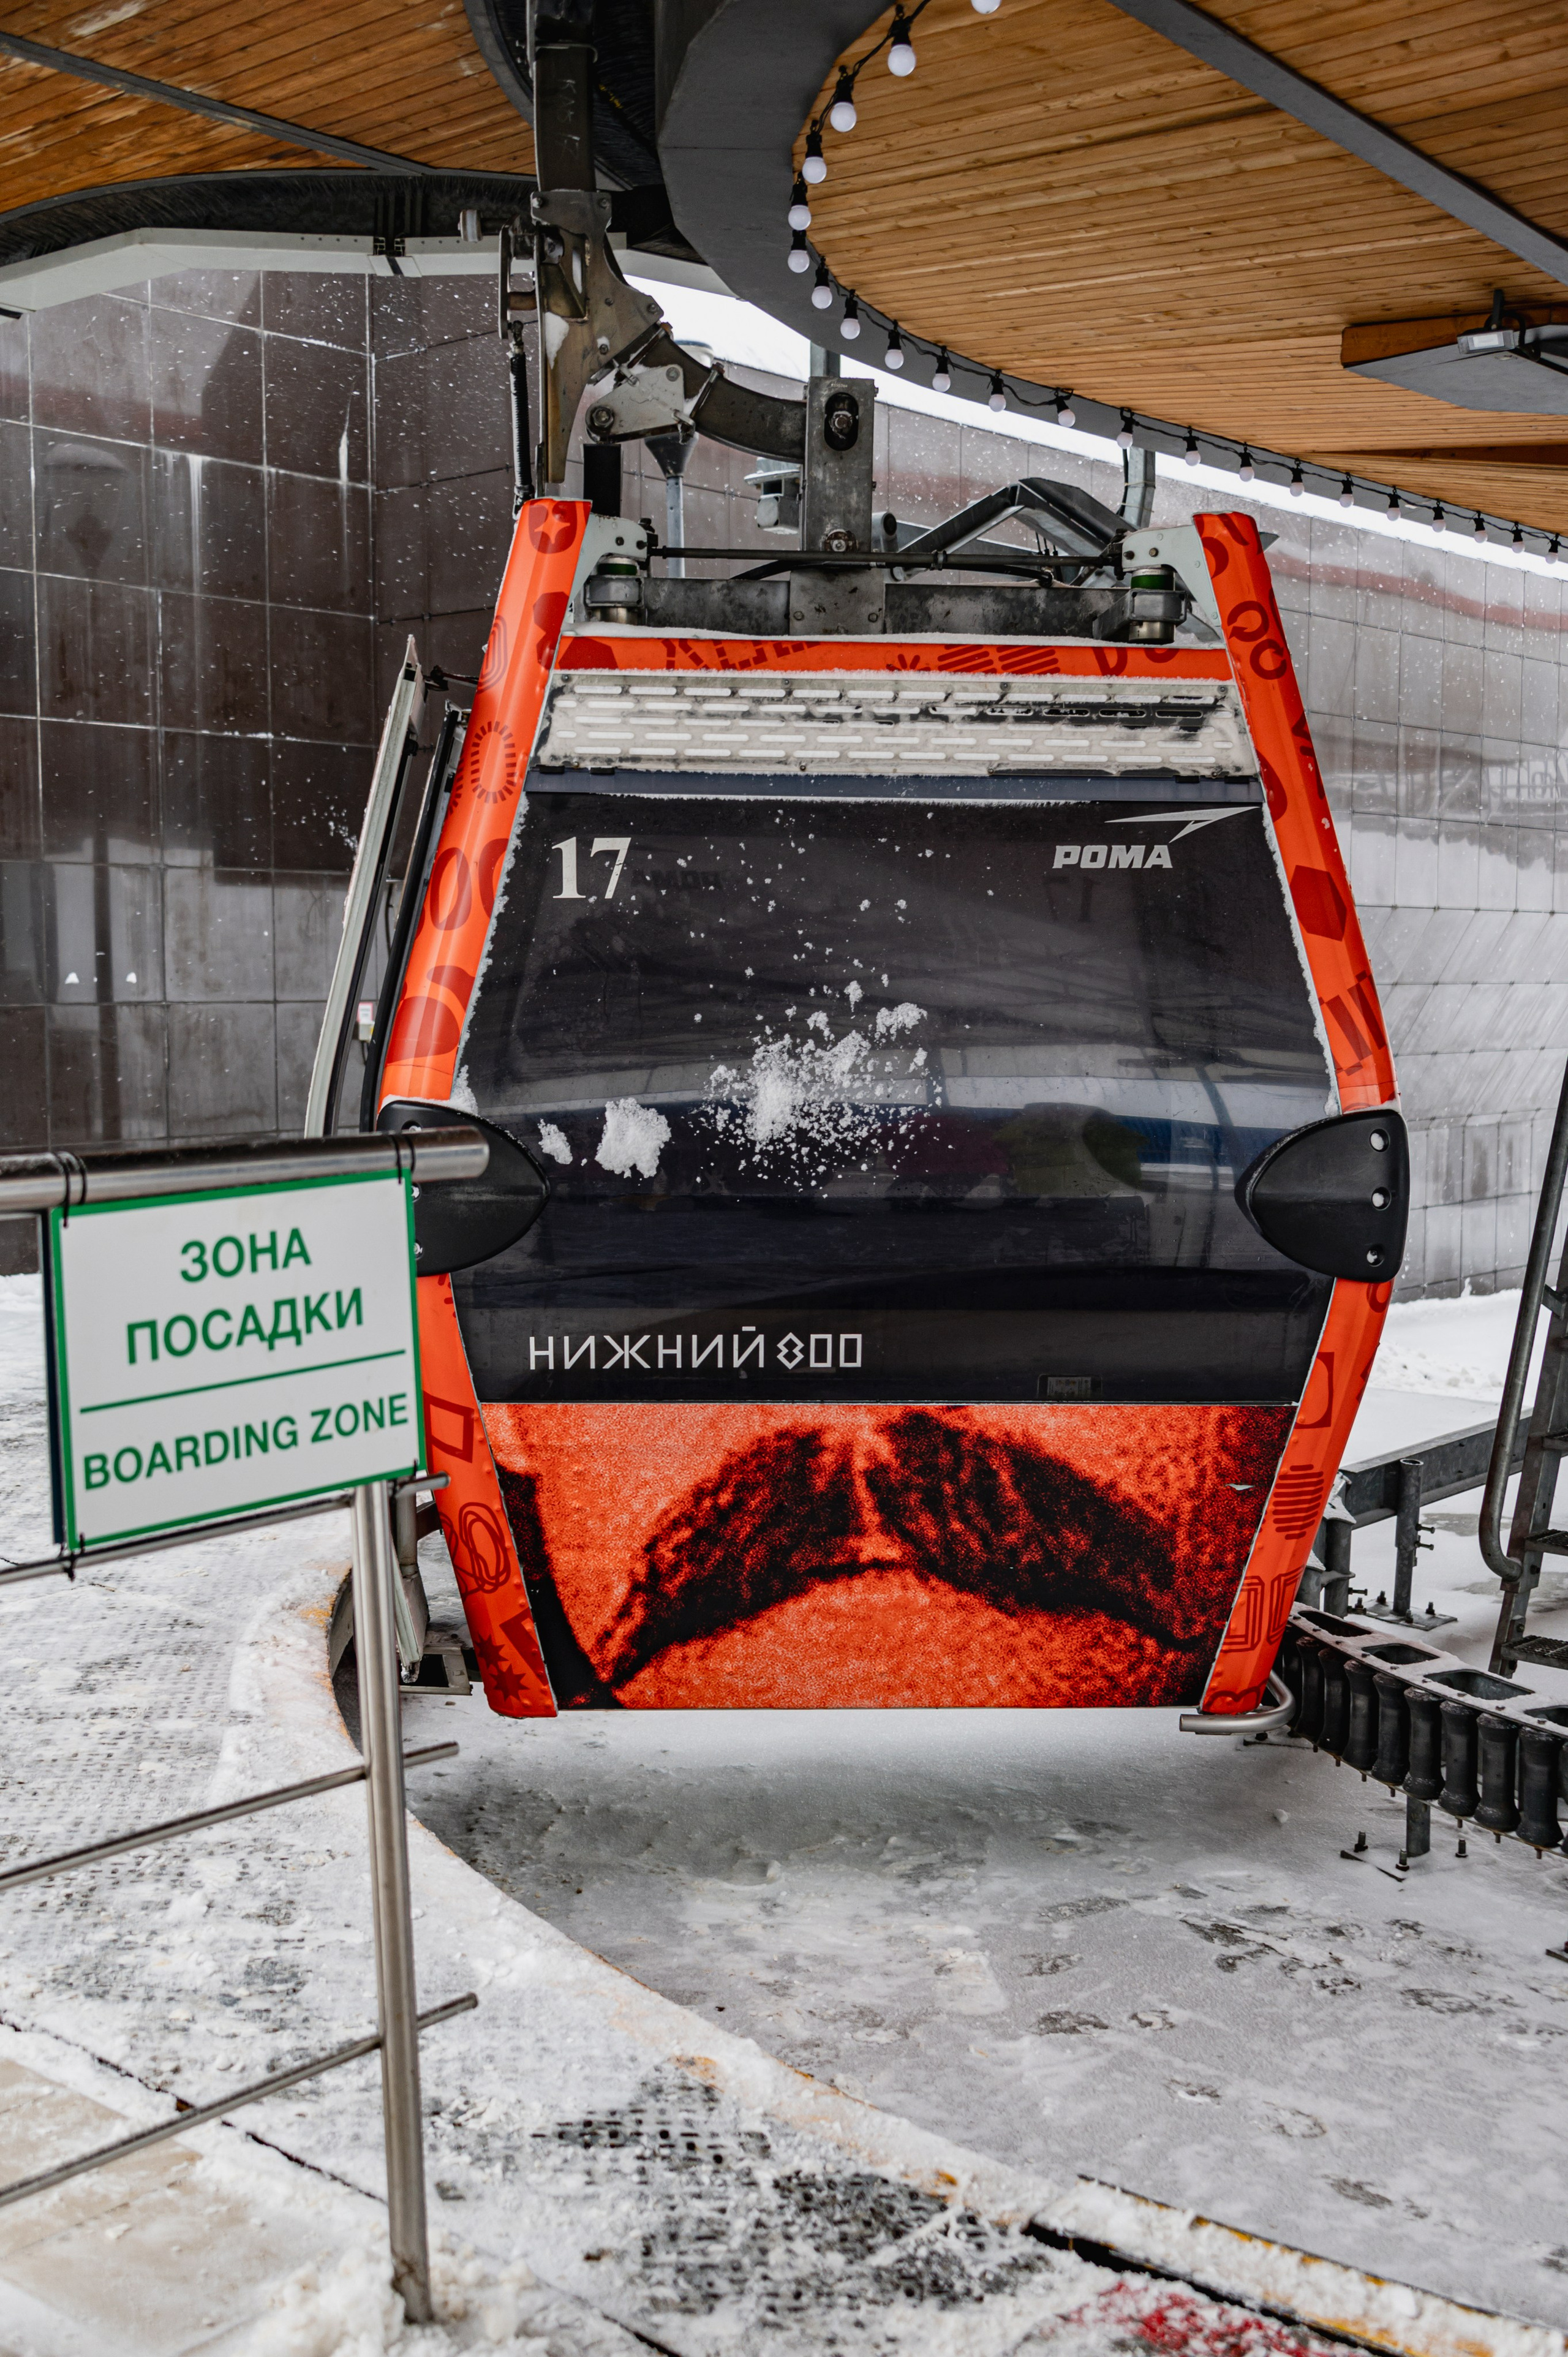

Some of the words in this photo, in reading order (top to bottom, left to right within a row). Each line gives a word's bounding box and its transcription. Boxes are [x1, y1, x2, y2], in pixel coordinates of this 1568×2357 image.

[552, 837, 631, 899] 17
[1052, 845, 1173, 869] POMA
[180, 1228, 312, 1283] ЗОНА
[126, 1287, 364, 1365] ПОСАДКИ
[529, 1326, 764, 1370] НИЖНИЙ
[776, 1332, 862, 1370] 800
[83, 1416, 298, 1491] BOARDING
[310, 1393, 409, 1444] ZONE
